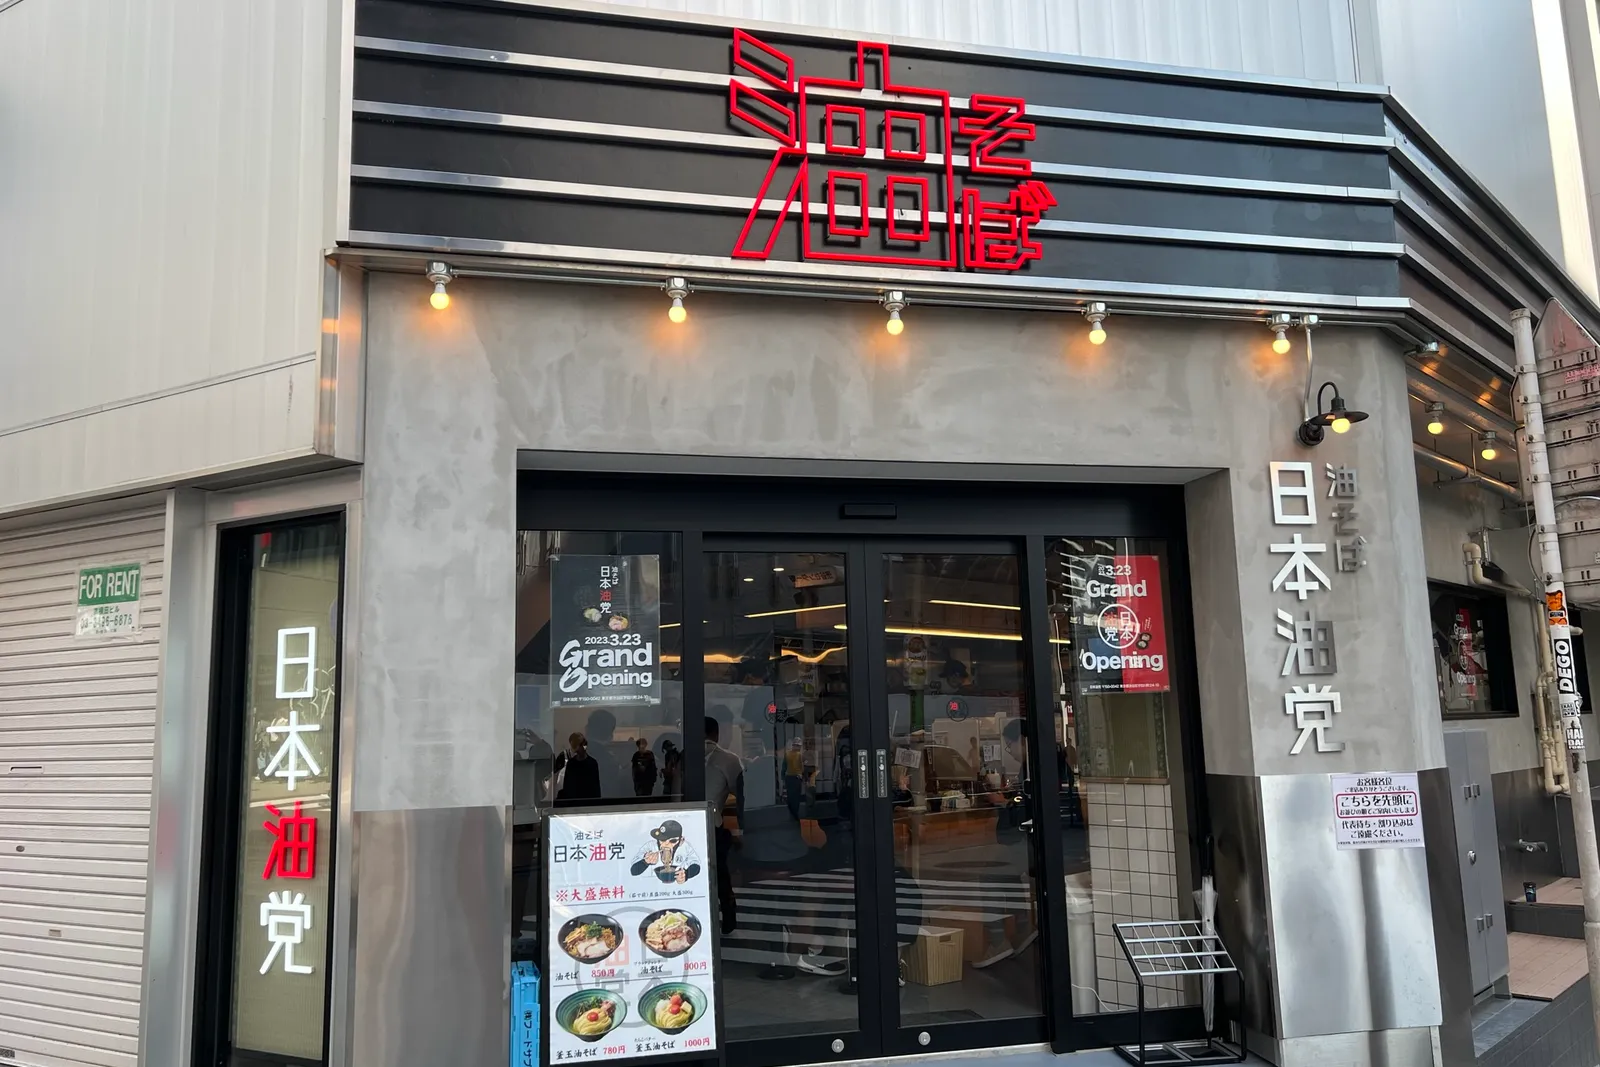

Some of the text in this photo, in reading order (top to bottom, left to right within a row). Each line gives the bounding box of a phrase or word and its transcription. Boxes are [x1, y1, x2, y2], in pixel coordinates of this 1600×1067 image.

[1326, 462, 1367, 573] 油そば
[79, 570, 139, 600] FOR RENT
[600, 566, 612, 614] 日本油党
[1086, 579, 1148, 597] Grand
[1269, 461, 1345, 756] 日本油党
[584, 634, 642, 646] 2023.3.23
[559, 639, 652, 669] Grand
[1082, 651, 1164, 673] Opening
[1555, 640, 1574, 693] DEGO
[559, 666, 652, 693] Opening
[1357, 777, 1392, 786] お客様各位
[259, 626, 321, 976] 日本油党
[1341, 794, 1413, 807] こちらを先頭に
[1342, 818, 1413, 829] 代表待ち・割り込みは
[574, 829, 603, 841] 油そば
[1350, 829, 1404, 838] ご遠慮ください。
[554, 842, 625, 864] 日本油党
[555, 968, 615, 981] 油そば 850円
[684, 962, 707, 971] 900円
[556, 1044, 626, 1060] 釜玉油そば 780円
[635, 1037, 710, 1054] 釜玉油そば 1000円
